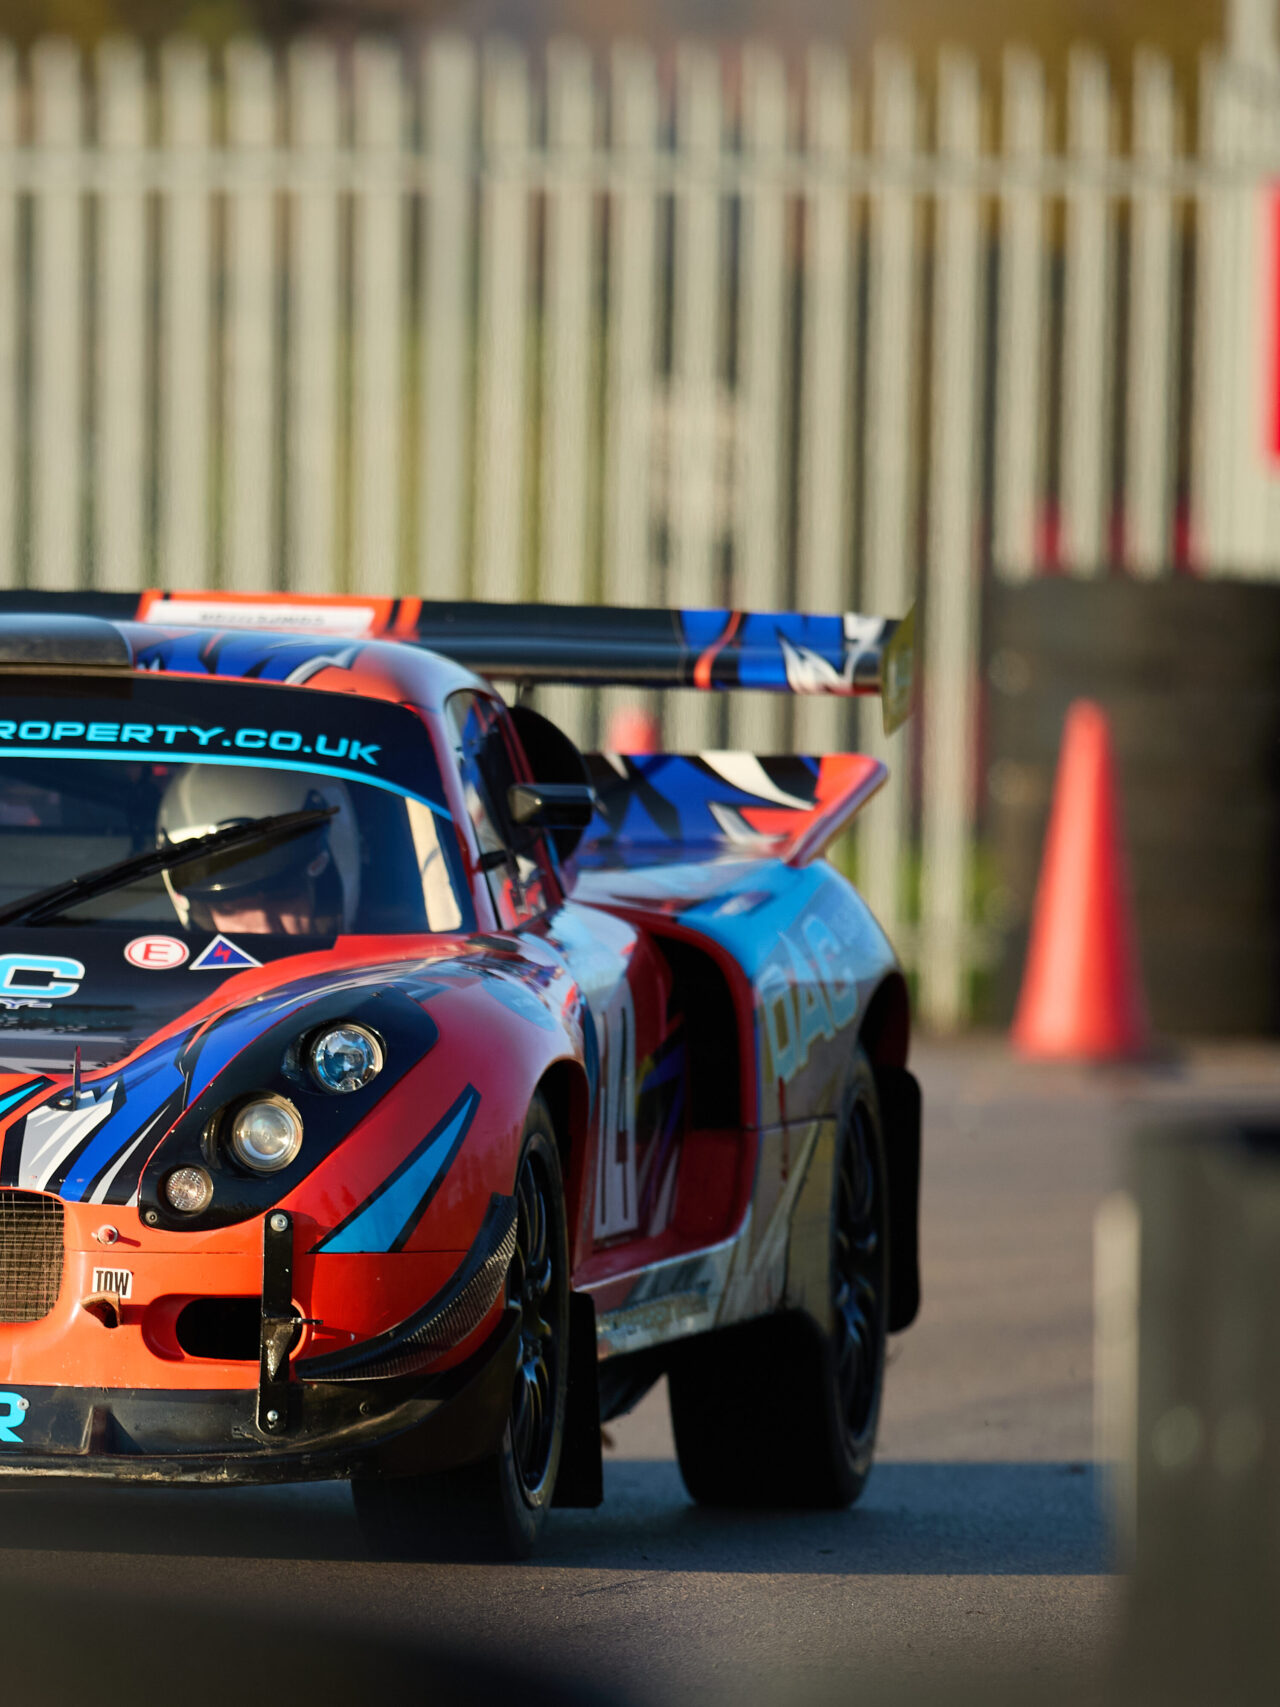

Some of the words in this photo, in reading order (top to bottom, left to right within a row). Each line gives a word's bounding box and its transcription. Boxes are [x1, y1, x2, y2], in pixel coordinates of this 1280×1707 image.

[143, 943, 171, 962] E
[756, 914, 860, 1085] DAC
[96, 1270, 130, 1296] TOW
